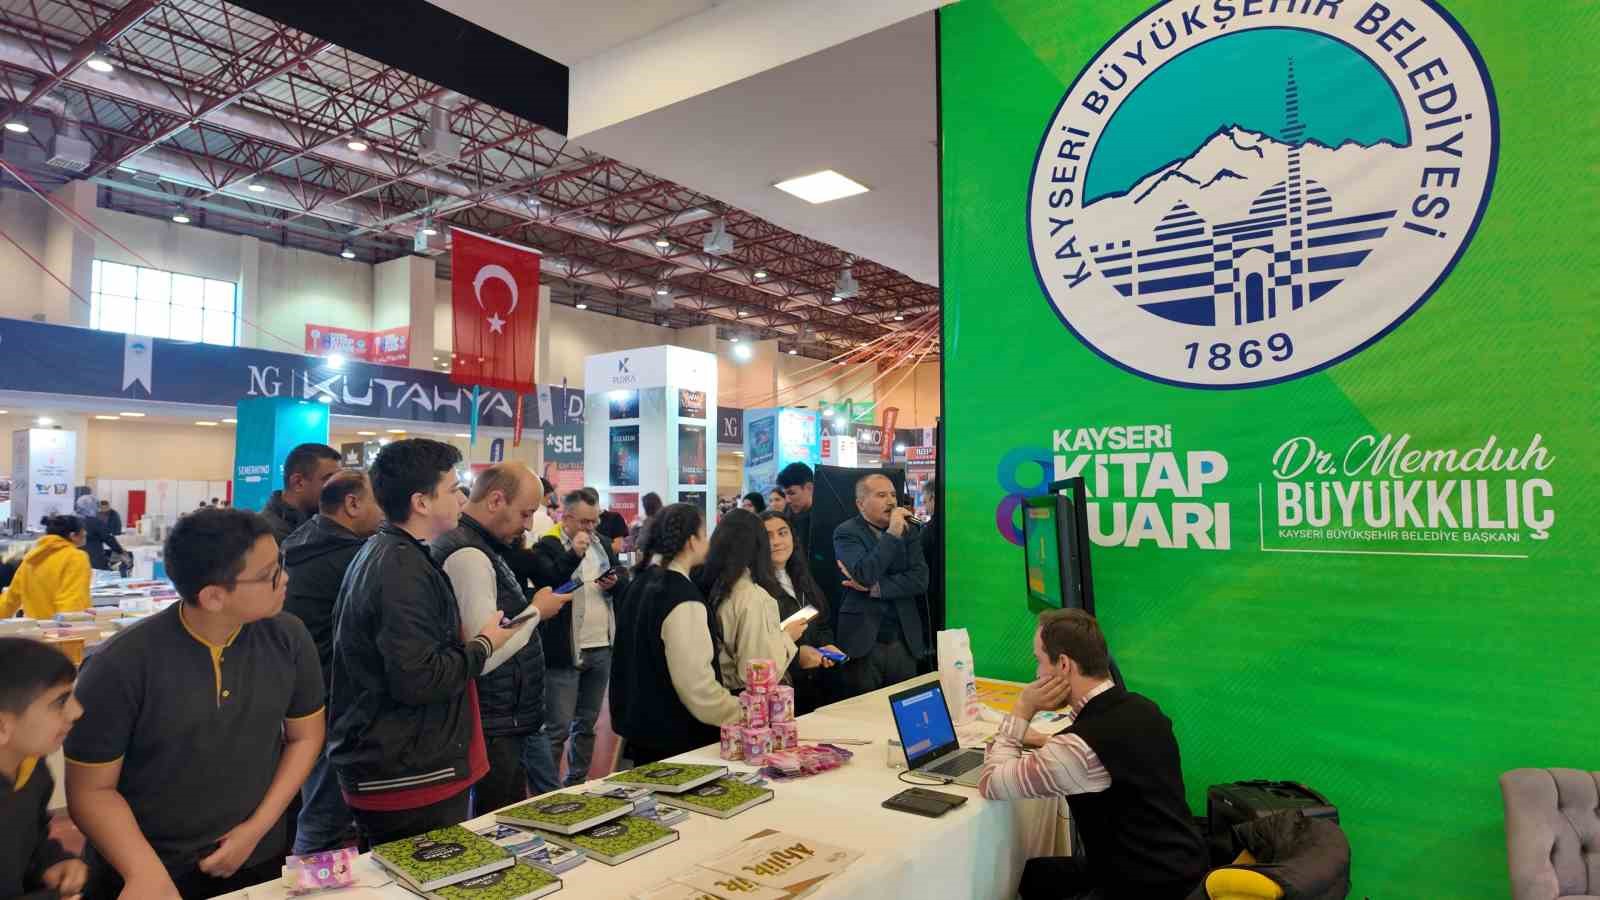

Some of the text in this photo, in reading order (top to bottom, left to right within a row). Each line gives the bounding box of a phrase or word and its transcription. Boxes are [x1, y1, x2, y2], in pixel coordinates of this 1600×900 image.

[1048, 125, 1091, 289] KAYSERİ
[1354, 1, 1472, 239] BELEDİYESİ
[1183, 332, 1294, 371] 1869
[247, 365, 283, 397] NG
[1052, 424, 1172, 451] KAYSERİ
[1272, 433, 1556, 480] Dr. Memduh
[1053, 450, 1229, 498] KİTAP
[1086, 502, 1231, 550] UARI
[1279, 529, 1324, 540] KAYSERİ
[1401, 529, 1459, 542] BELEDİYE
[1463, 531, 1520, 543] BAŞKANI
